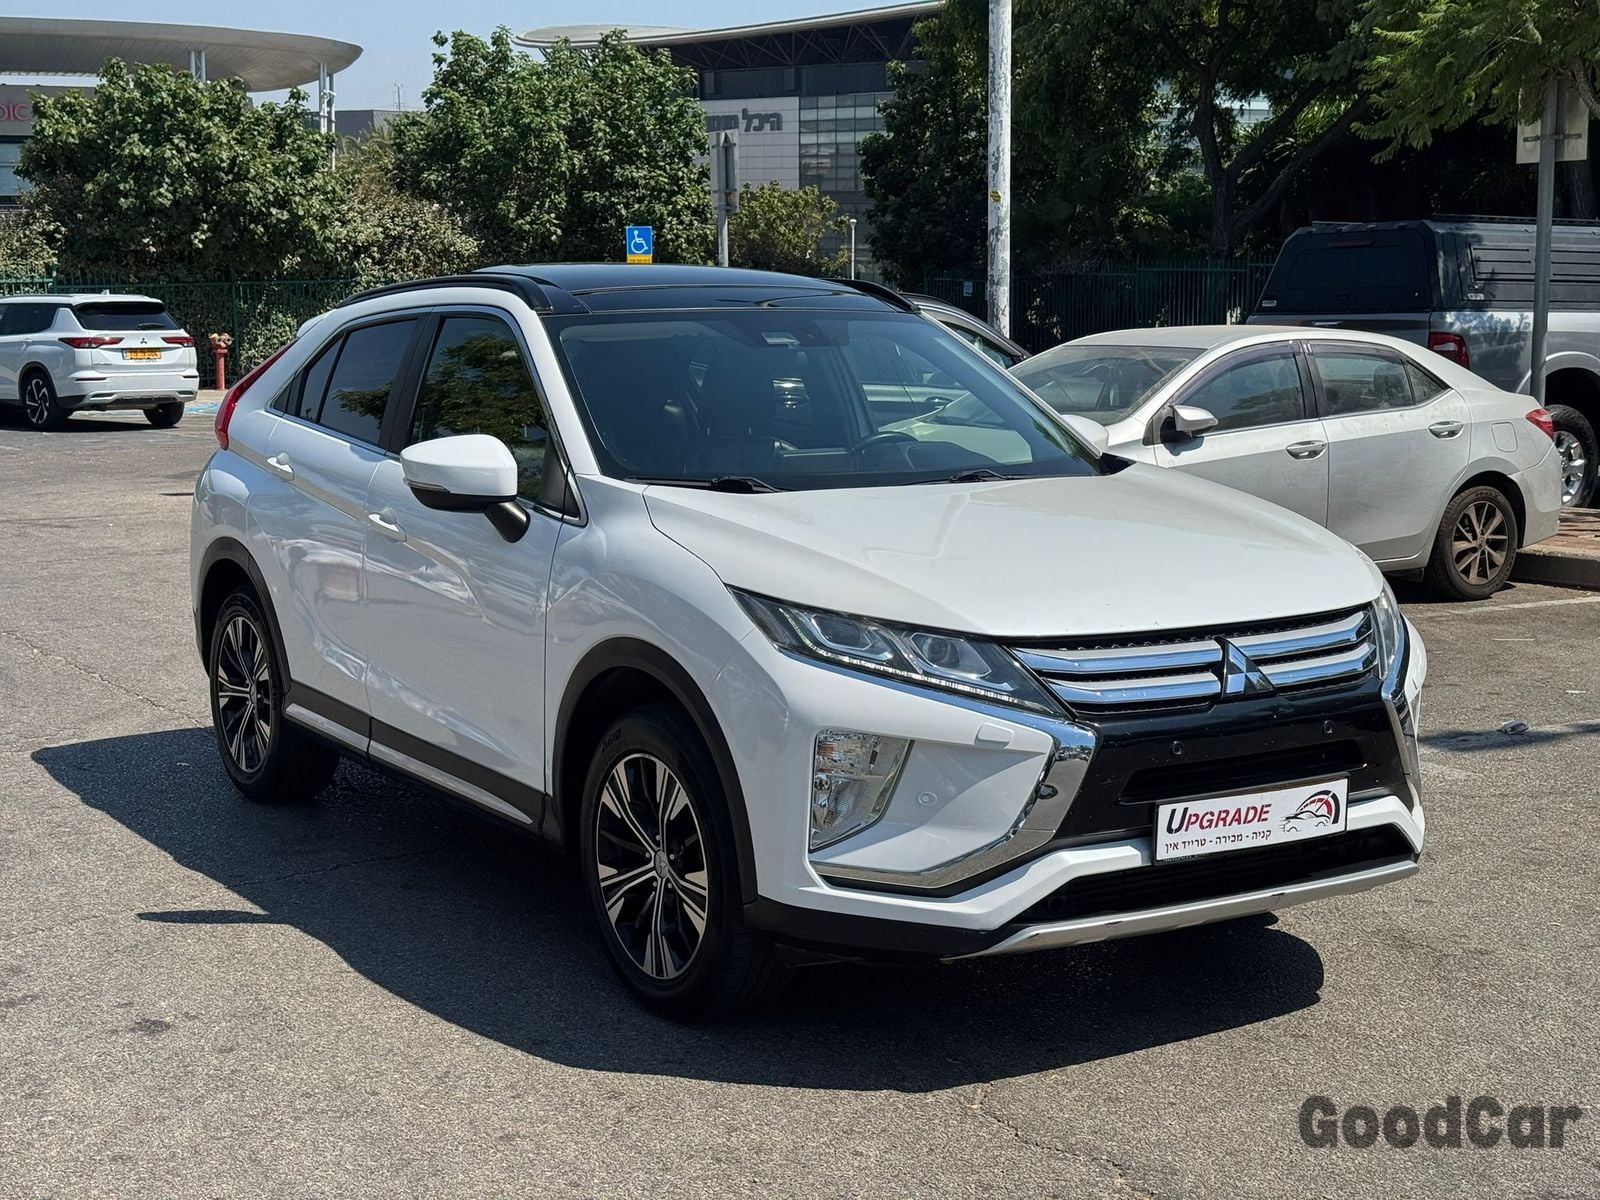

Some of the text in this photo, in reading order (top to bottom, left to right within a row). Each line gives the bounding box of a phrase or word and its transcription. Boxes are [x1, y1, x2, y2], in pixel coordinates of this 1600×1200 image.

[742, 108, 783, 132] היכל
[1166, 803, 1272, 834] UPGRADE
[1215, 832, 1243, 844] מכירה
[1251, 829, 1272, 841] קניה
[1165, 842, 1179, 854] אין
[1183, 838, 1207, 849] טרייד
